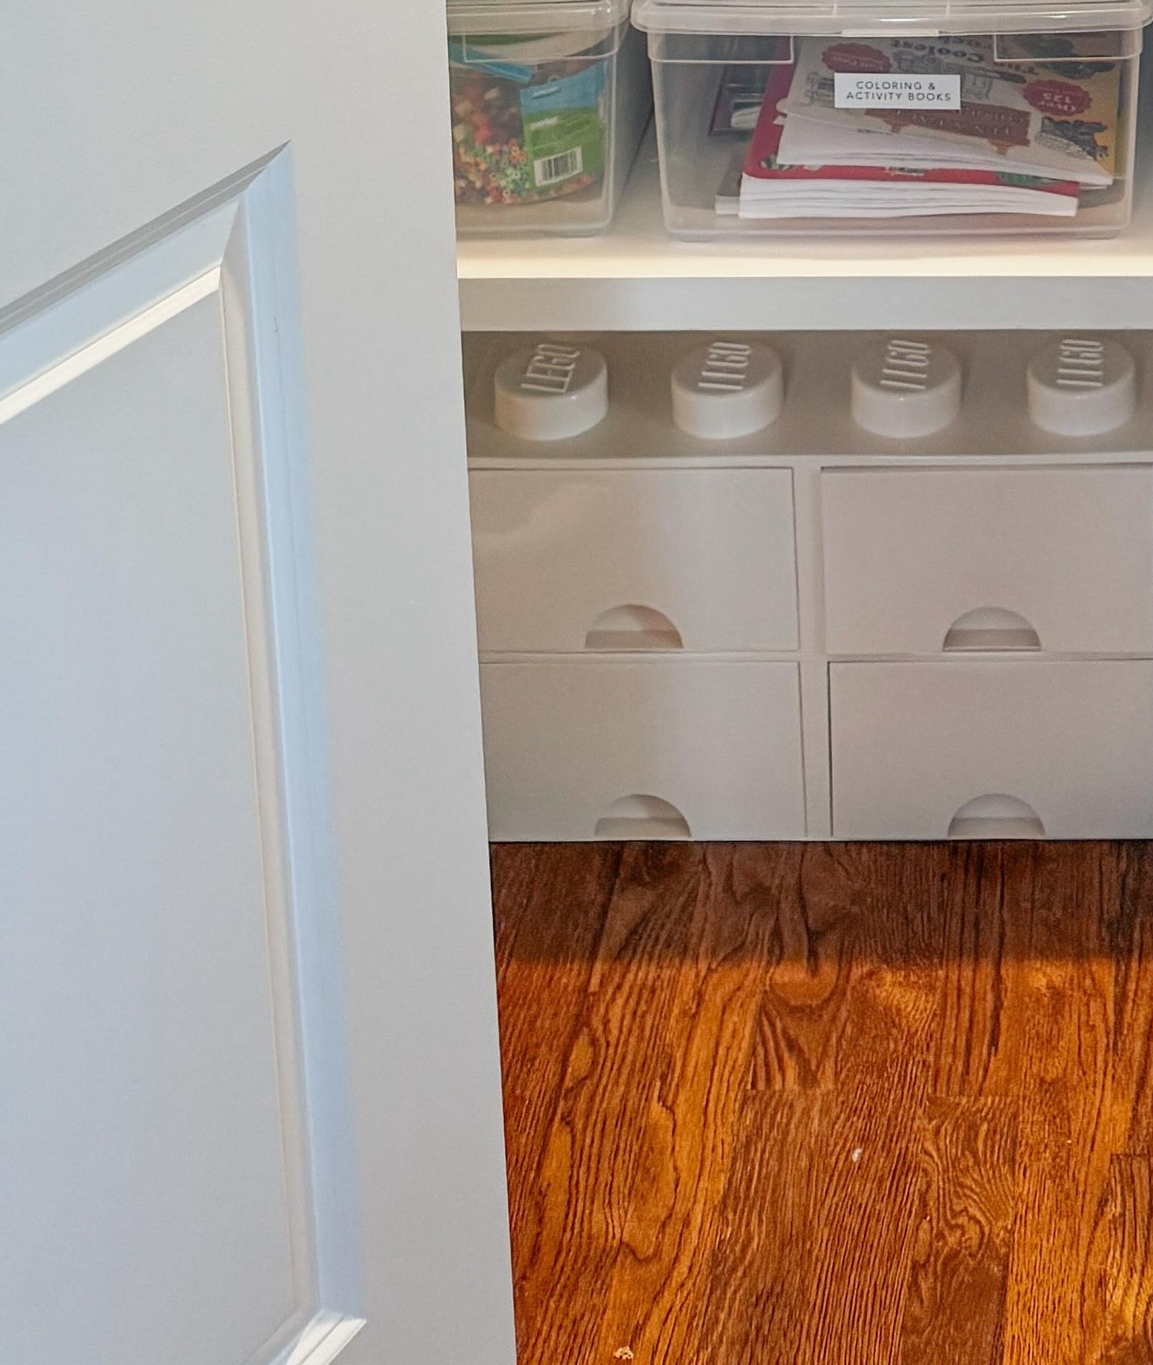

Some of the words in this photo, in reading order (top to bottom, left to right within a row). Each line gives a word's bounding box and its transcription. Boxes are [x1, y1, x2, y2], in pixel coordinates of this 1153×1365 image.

[856, 81, 923, 90] COLORING
[928, 82, 936, 90] &
[846, 91, 901, 101] ACTIVITY
[908, 92, 951, 102] BOOKS
